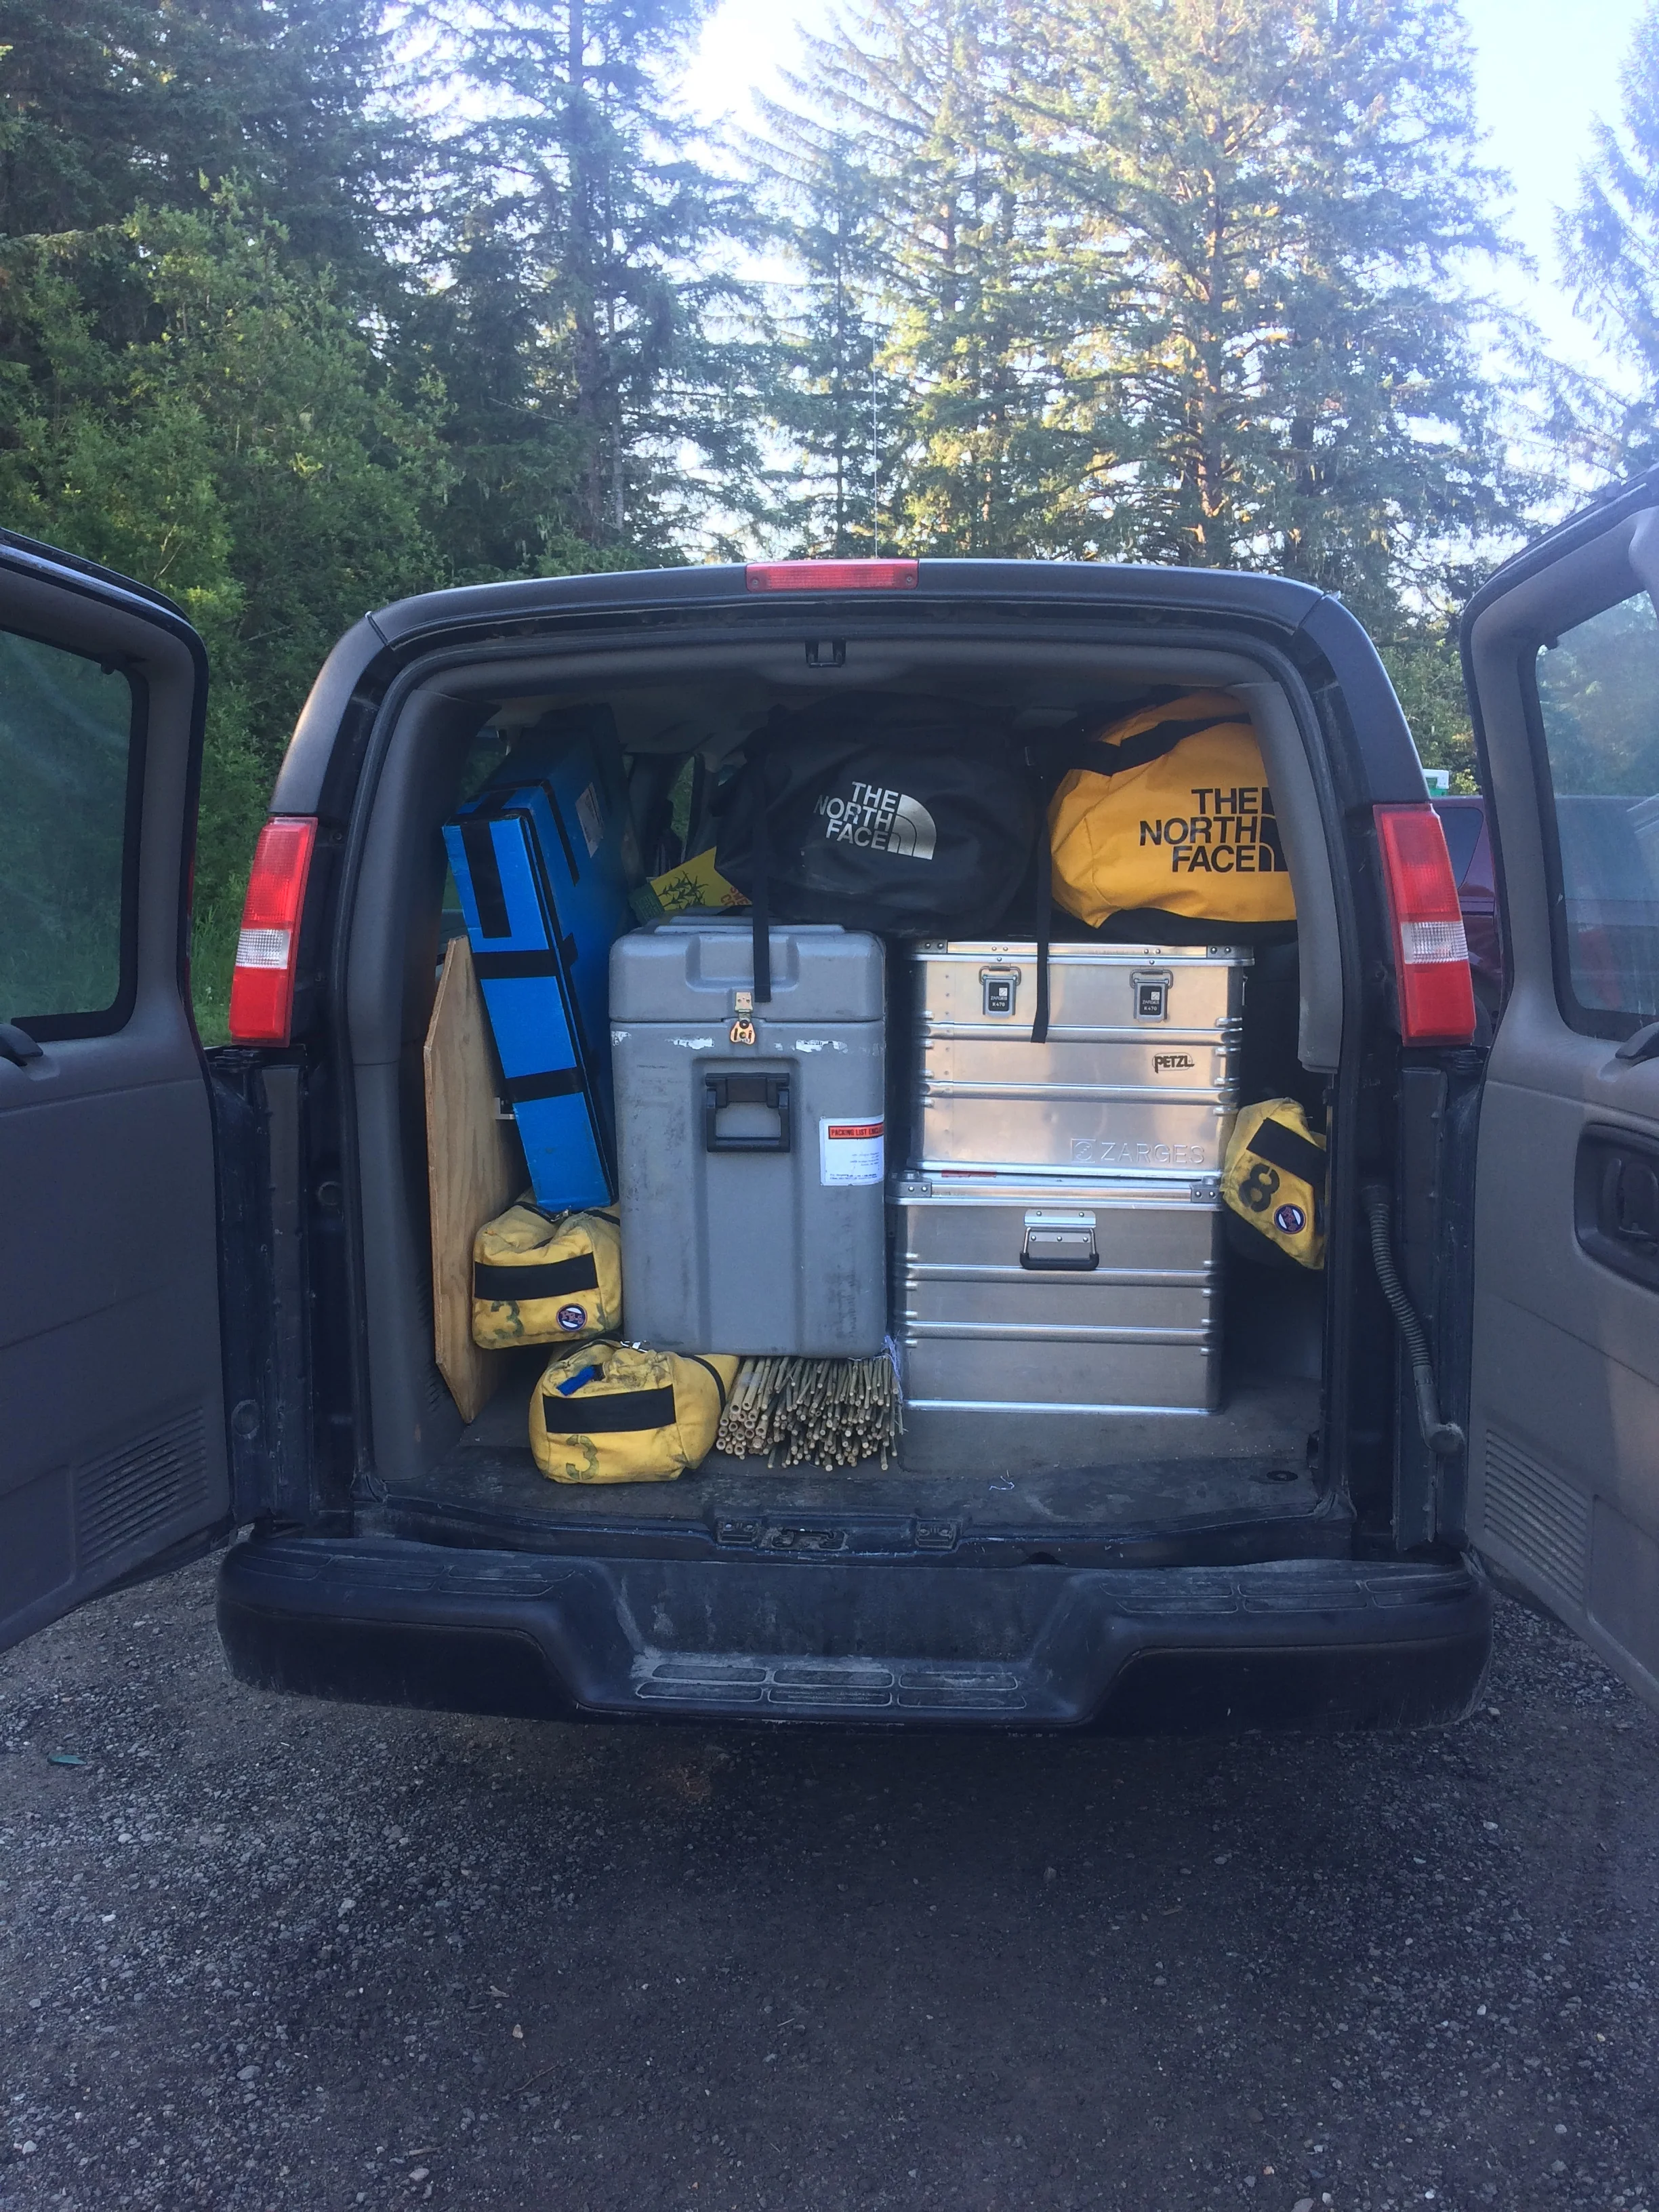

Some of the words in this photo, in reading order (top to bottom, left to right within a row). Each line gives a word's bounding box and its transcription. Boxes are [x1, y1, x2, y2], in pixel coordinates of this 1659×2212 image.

[852, 781, 899, 813] THE
[1191, 787, 1258, 815] THE
[813, 794, 893, 832] NORTH
[826, 819, 889, 851] FACE
[1140, 816, 1258, 846] NORTH
[1172, 845, 1256, 872] FACE
[1154, 1055, 1195, 1074] PETZL
[831, 1128, 855, 1136] PACKING
[1100, 1142, 1206, 1164] ZARGES
[1238, 1162, 1280, 1212] 8
[491, 1300, 525, 1340] 3
[565, 1434, 599, 1481] 3
